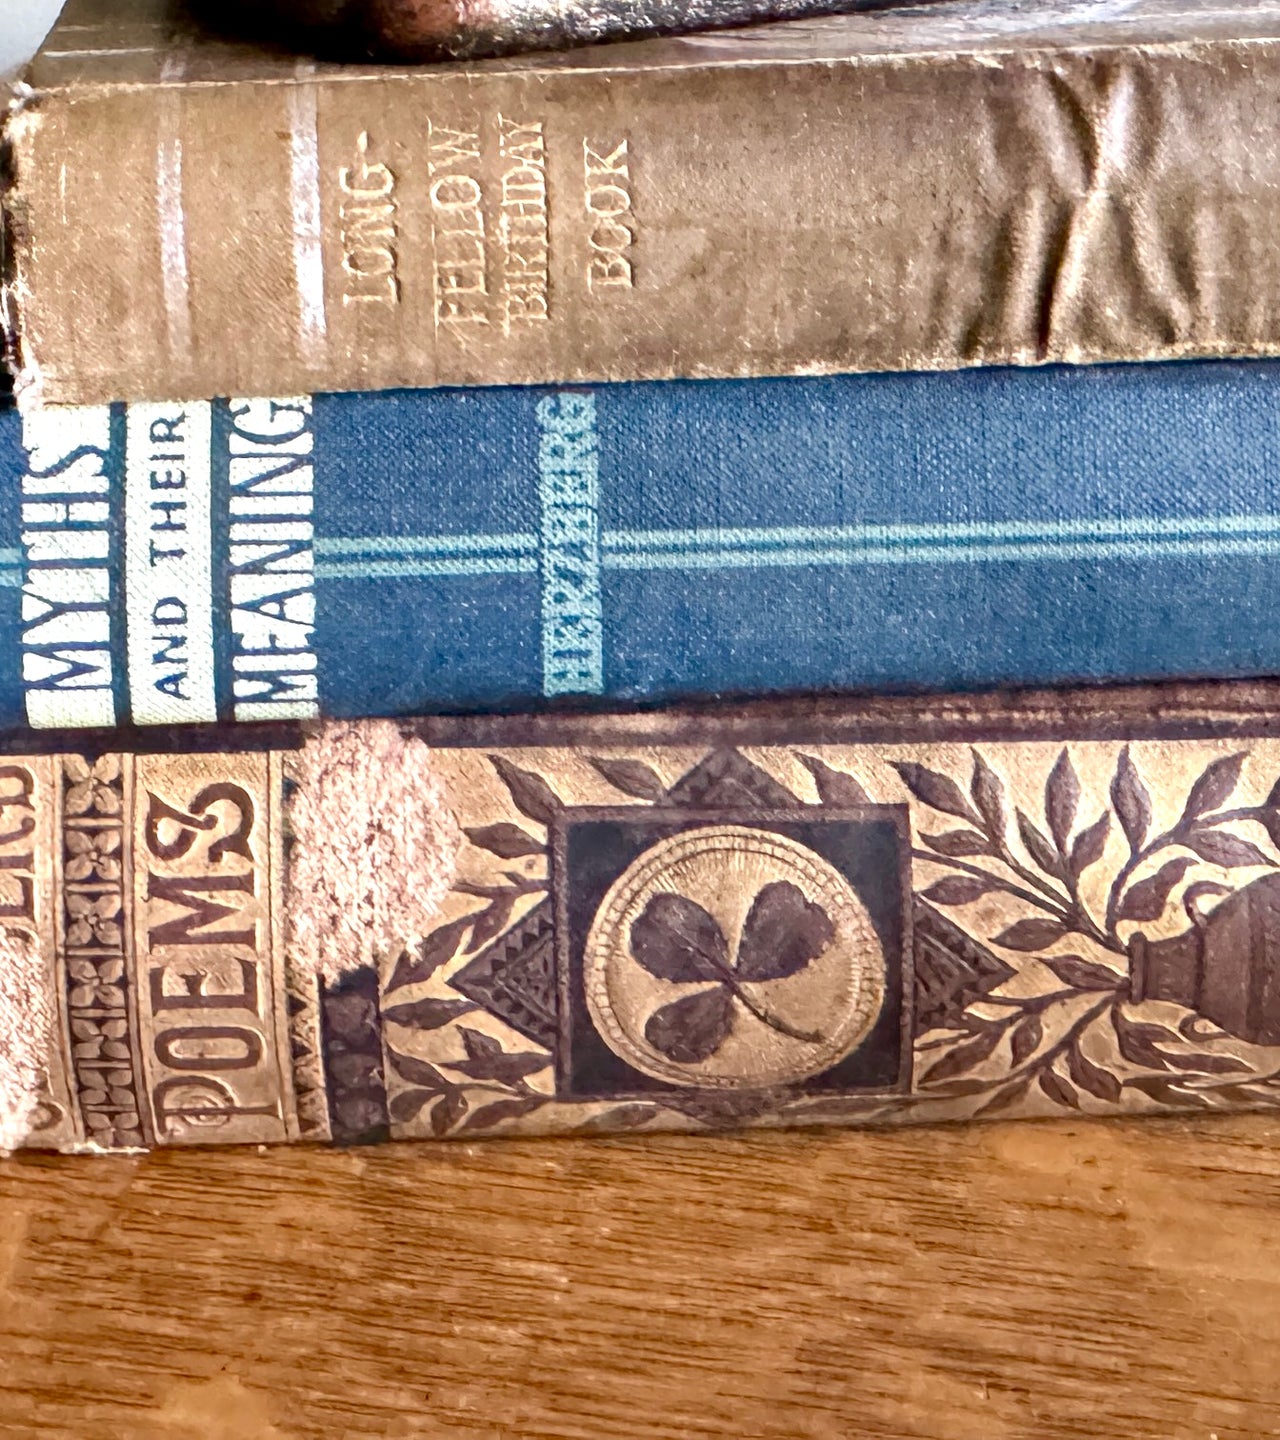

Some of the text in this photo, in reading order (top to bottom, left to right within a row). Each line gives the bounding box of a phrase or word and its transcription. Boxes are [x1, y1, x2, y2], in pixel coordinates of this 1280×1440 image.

[339, 130, 400, 306] LONG-
[425, 114, 489, 328] FELLOW
[496, 112, 549, 336] BIRTHDAY
[582, 137, 633, 294] BOOK
[22, 443, 112, 694] MYTHS
[146, 409, 190, 702] AND THEIR
[229, 398, 316, 706] MEANING
[536, 391, 604, 698] HERZBERG
[144, 781, 278, 1131] POEMS
